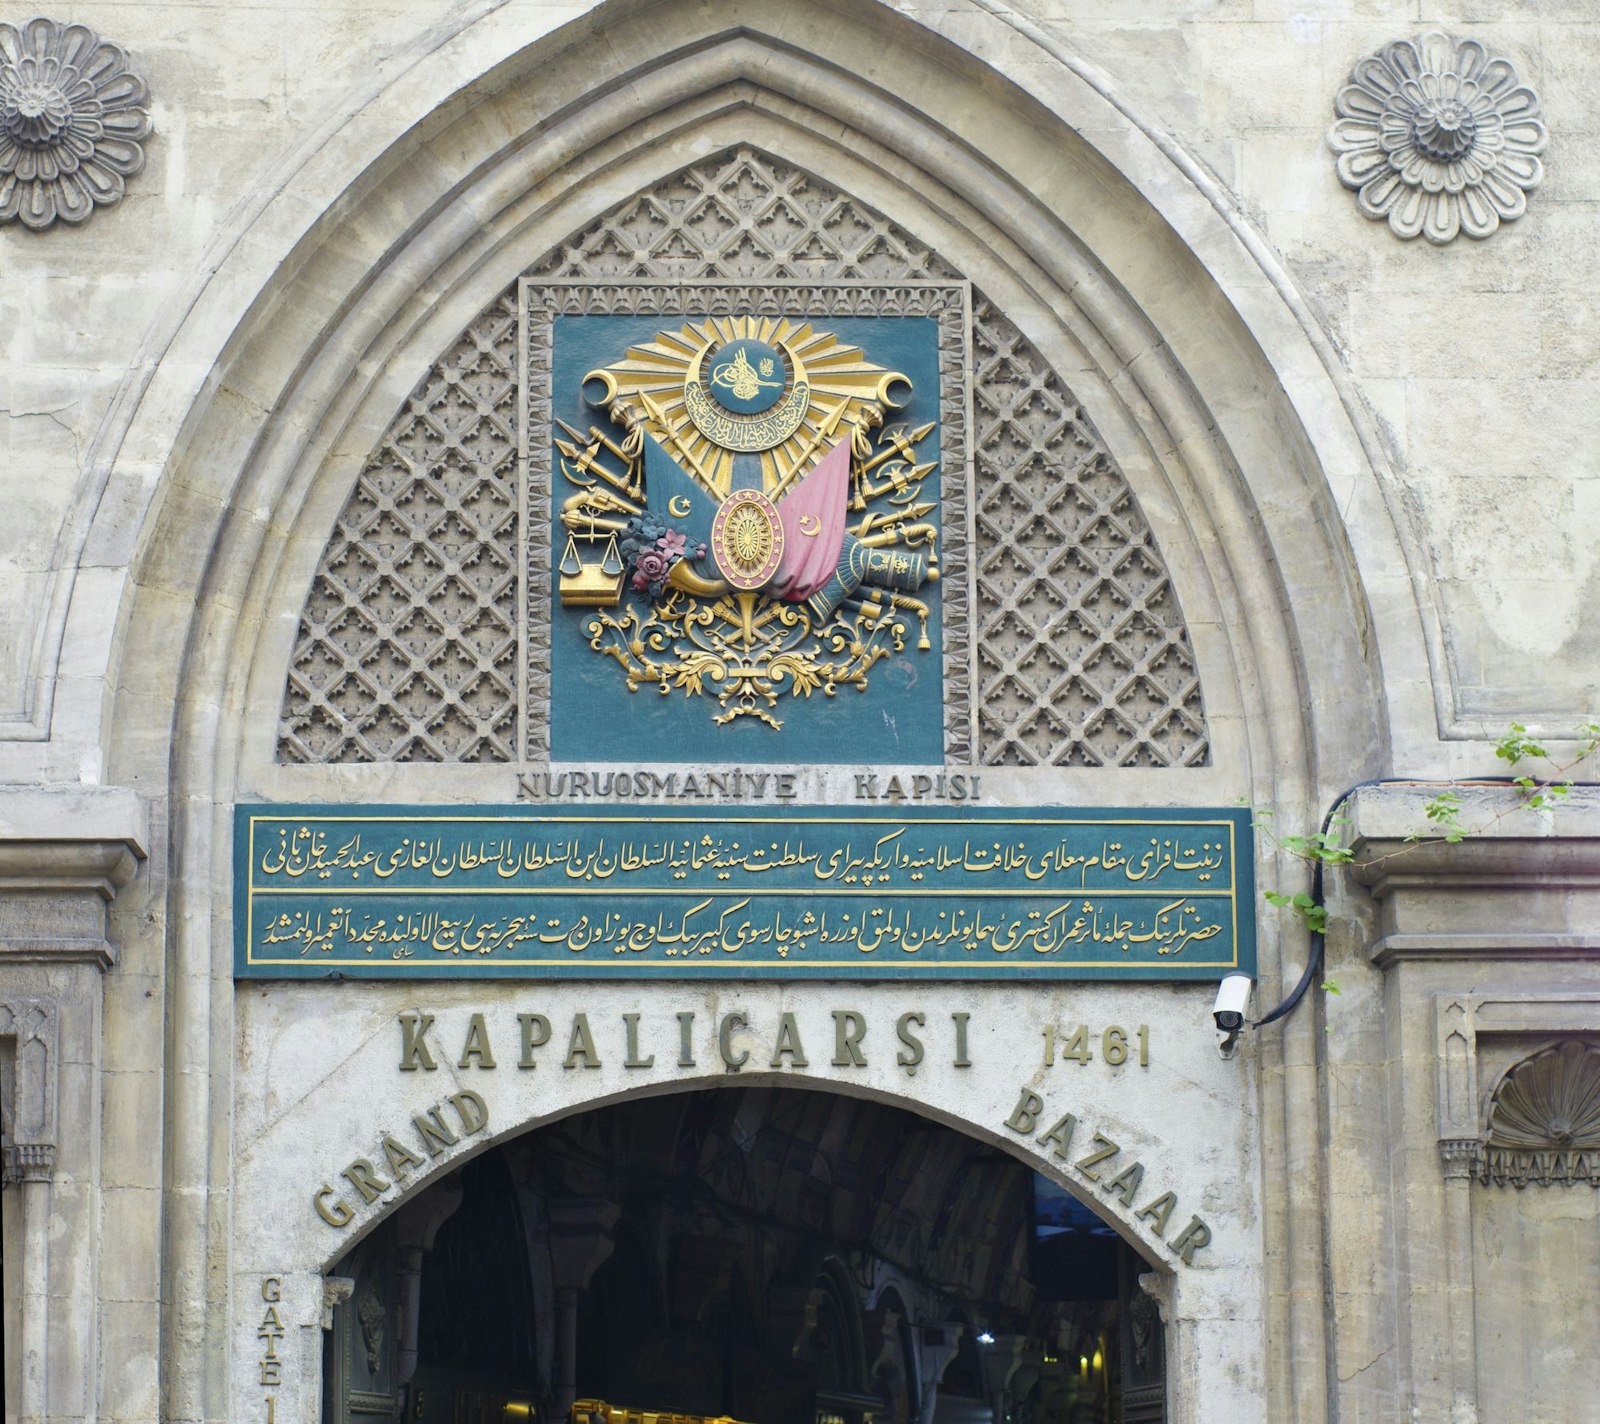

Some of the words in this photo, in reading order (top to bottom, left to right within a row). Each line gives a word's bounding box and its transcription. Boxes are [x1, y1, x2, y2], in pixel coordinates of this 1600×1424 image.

[516, 767, 798, 800] NURUOSMANİYE
[854, 773, 981, 800] KAPISI
[1042, 1023, 1149, 1066] 1461
[313, 1089, 489, 1227] GRAND
[1003, 1086, 1212, 1265] BAZAAR
[258, 1275, 285, 1386] GATE
